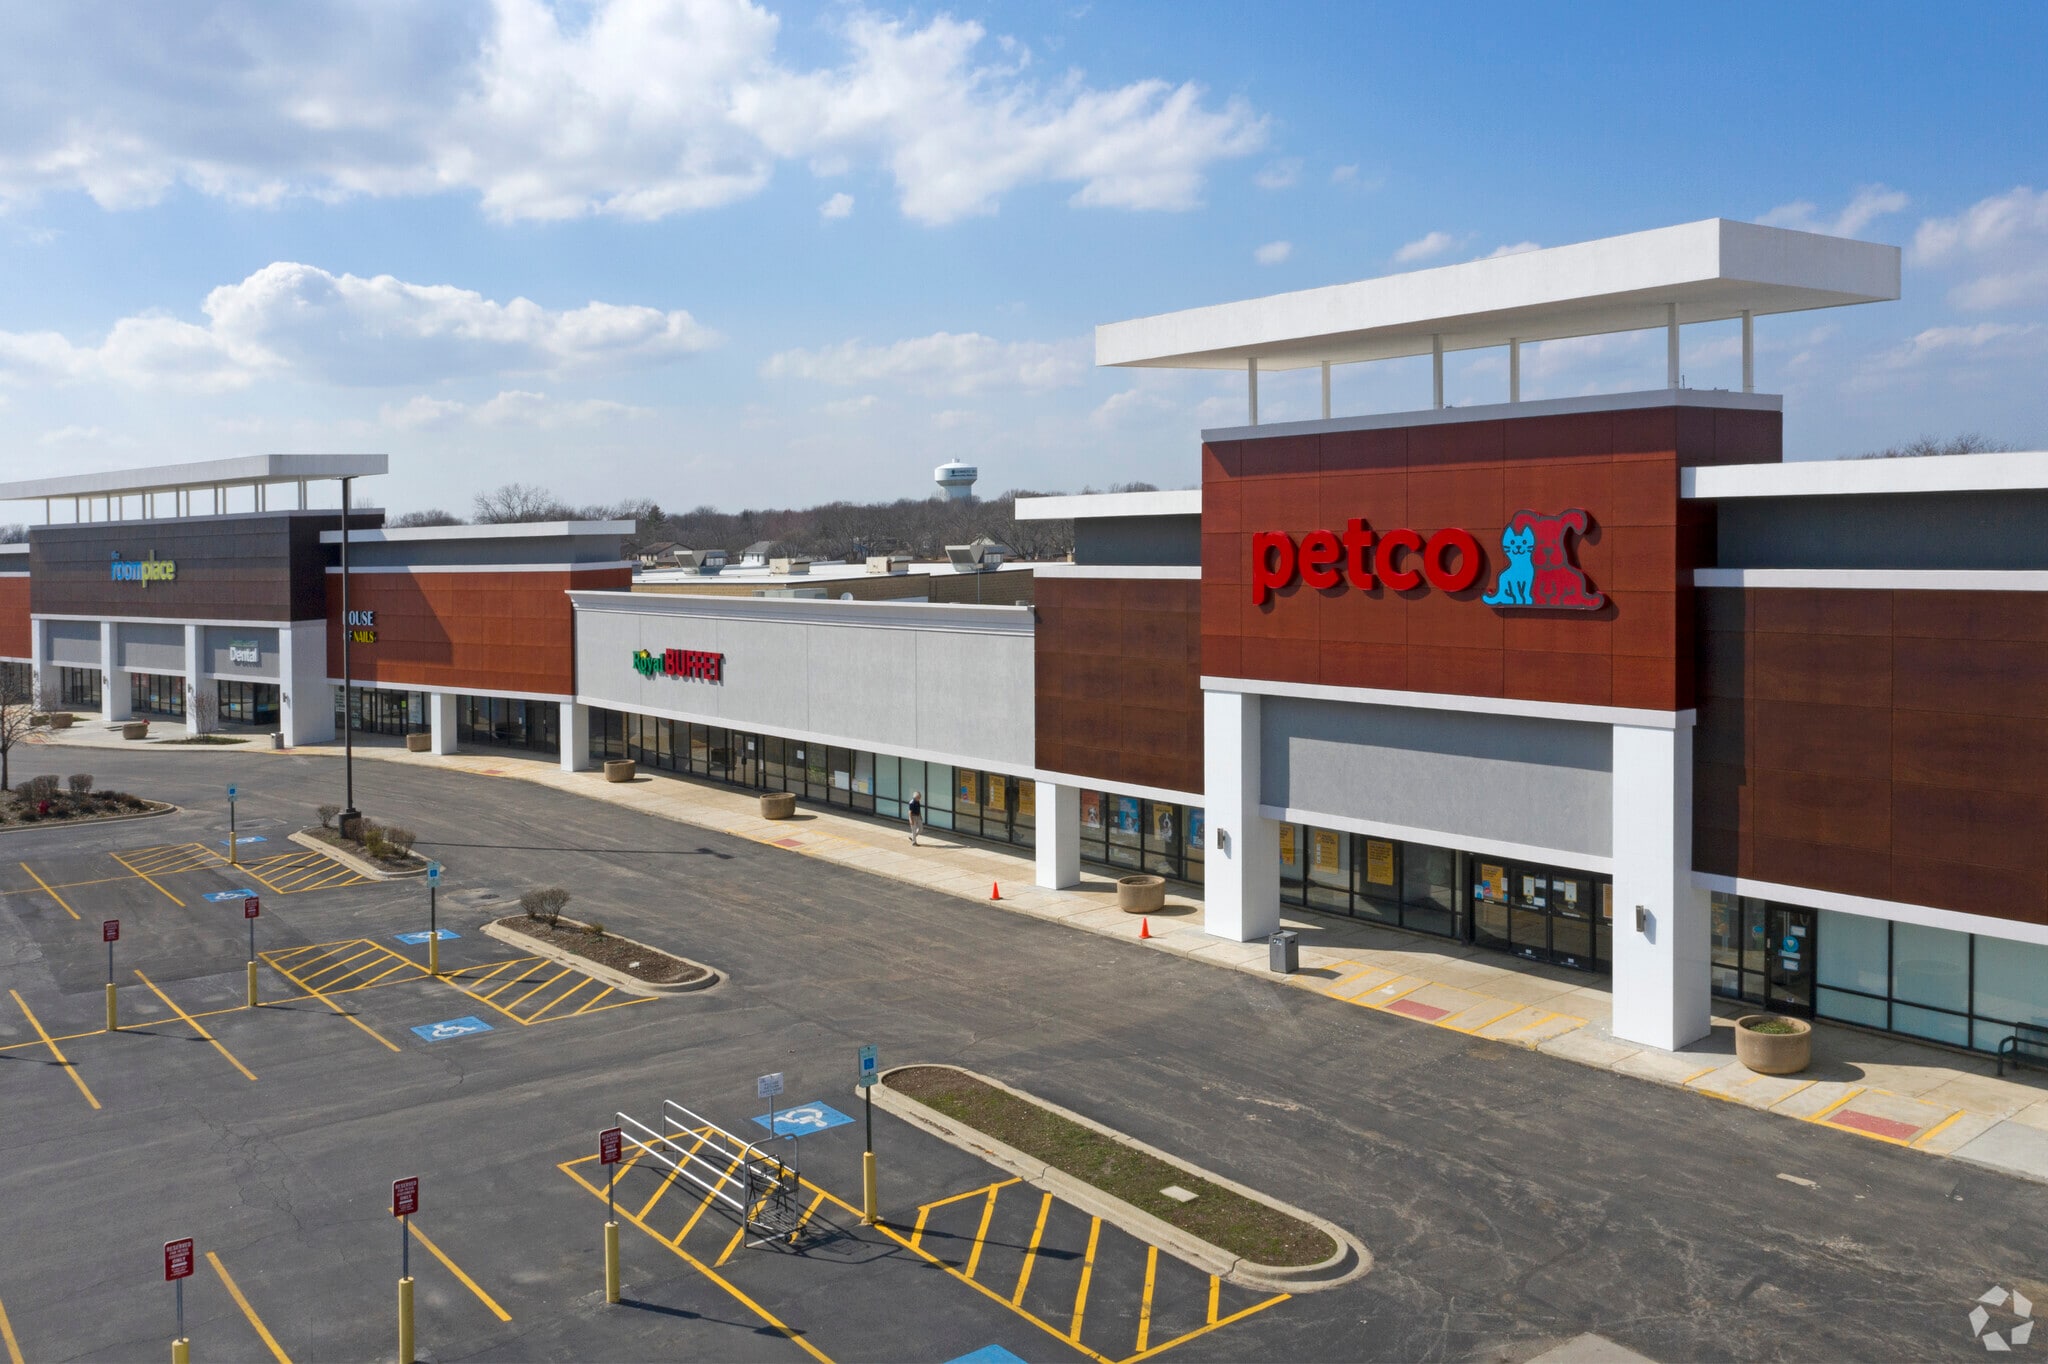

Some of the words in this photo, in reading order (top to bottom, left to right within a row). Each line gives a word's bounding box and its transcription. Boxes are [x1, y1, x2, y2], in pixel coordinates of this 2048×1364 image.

[111, 549, 175, 588] roomplace
[1252, 518, 1481, 606] petco
[347, 610, 374, 626] OUSE
[353, 631, 375, 643] NAILS
[230, 646, 258, 663] Dental
[632, 649, 664, 676] Royal
[665, 648, 723, 682] BUFFET
